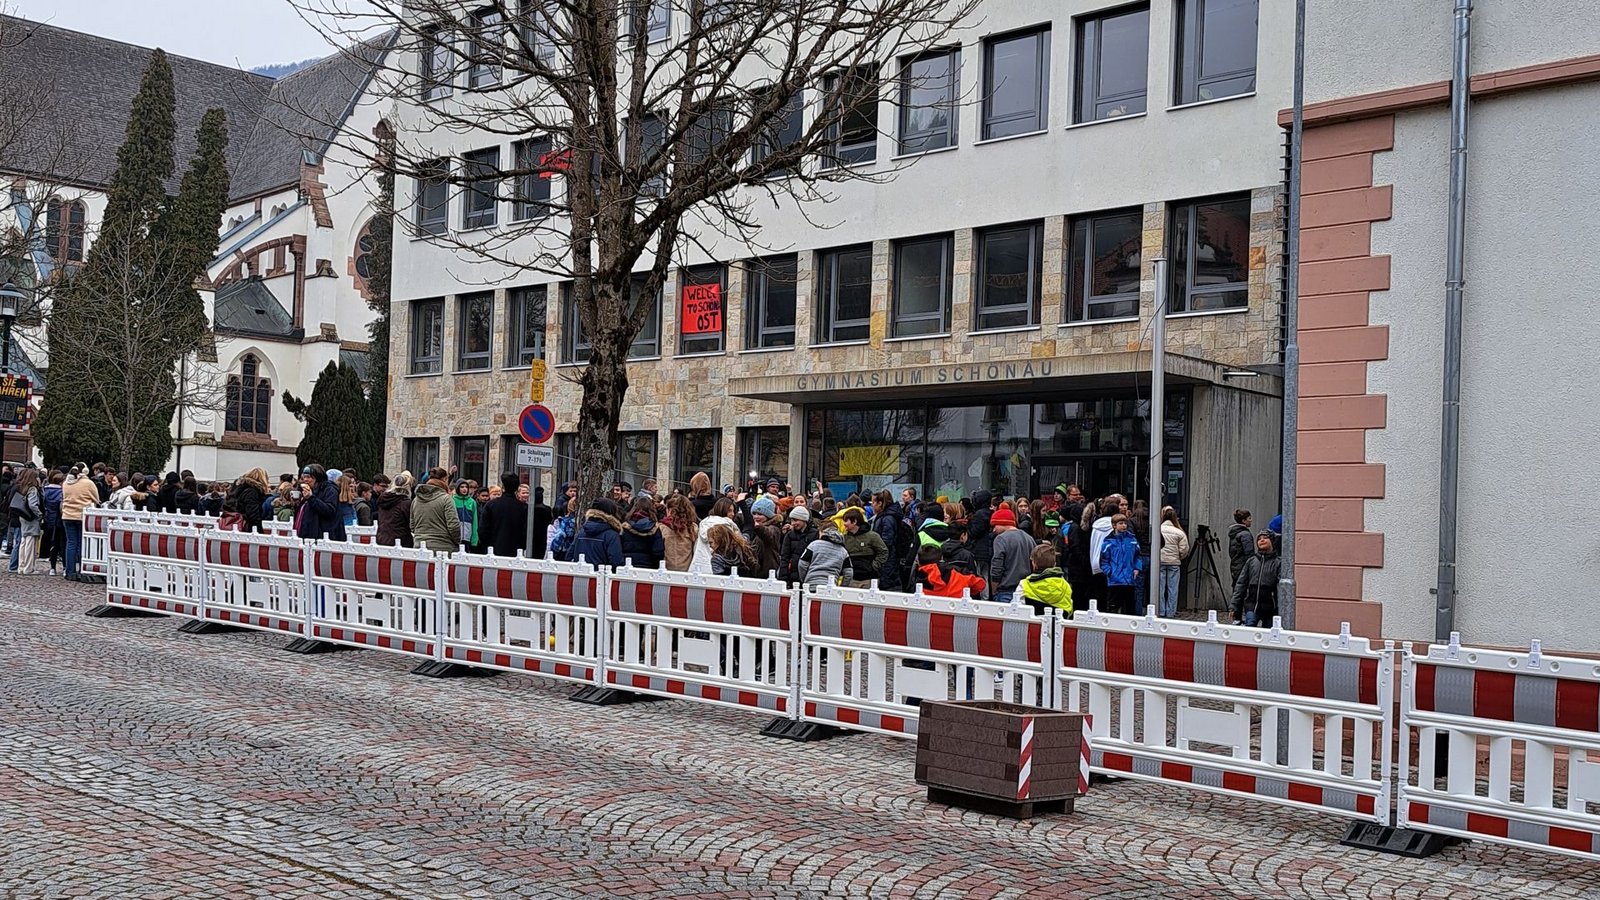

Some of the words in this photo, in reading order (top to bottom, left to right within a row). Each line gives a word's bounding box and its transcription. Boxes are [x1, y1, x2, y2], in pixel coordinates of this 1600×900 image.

[687, 303, 698, 314] TO
[697, 312, 718, 330] OST
[797, 370, 922, 390] GYMNASIUM
[938, 360, 1052, 382] SCHÖNAU
[2, 378, 17, 387] SIE
